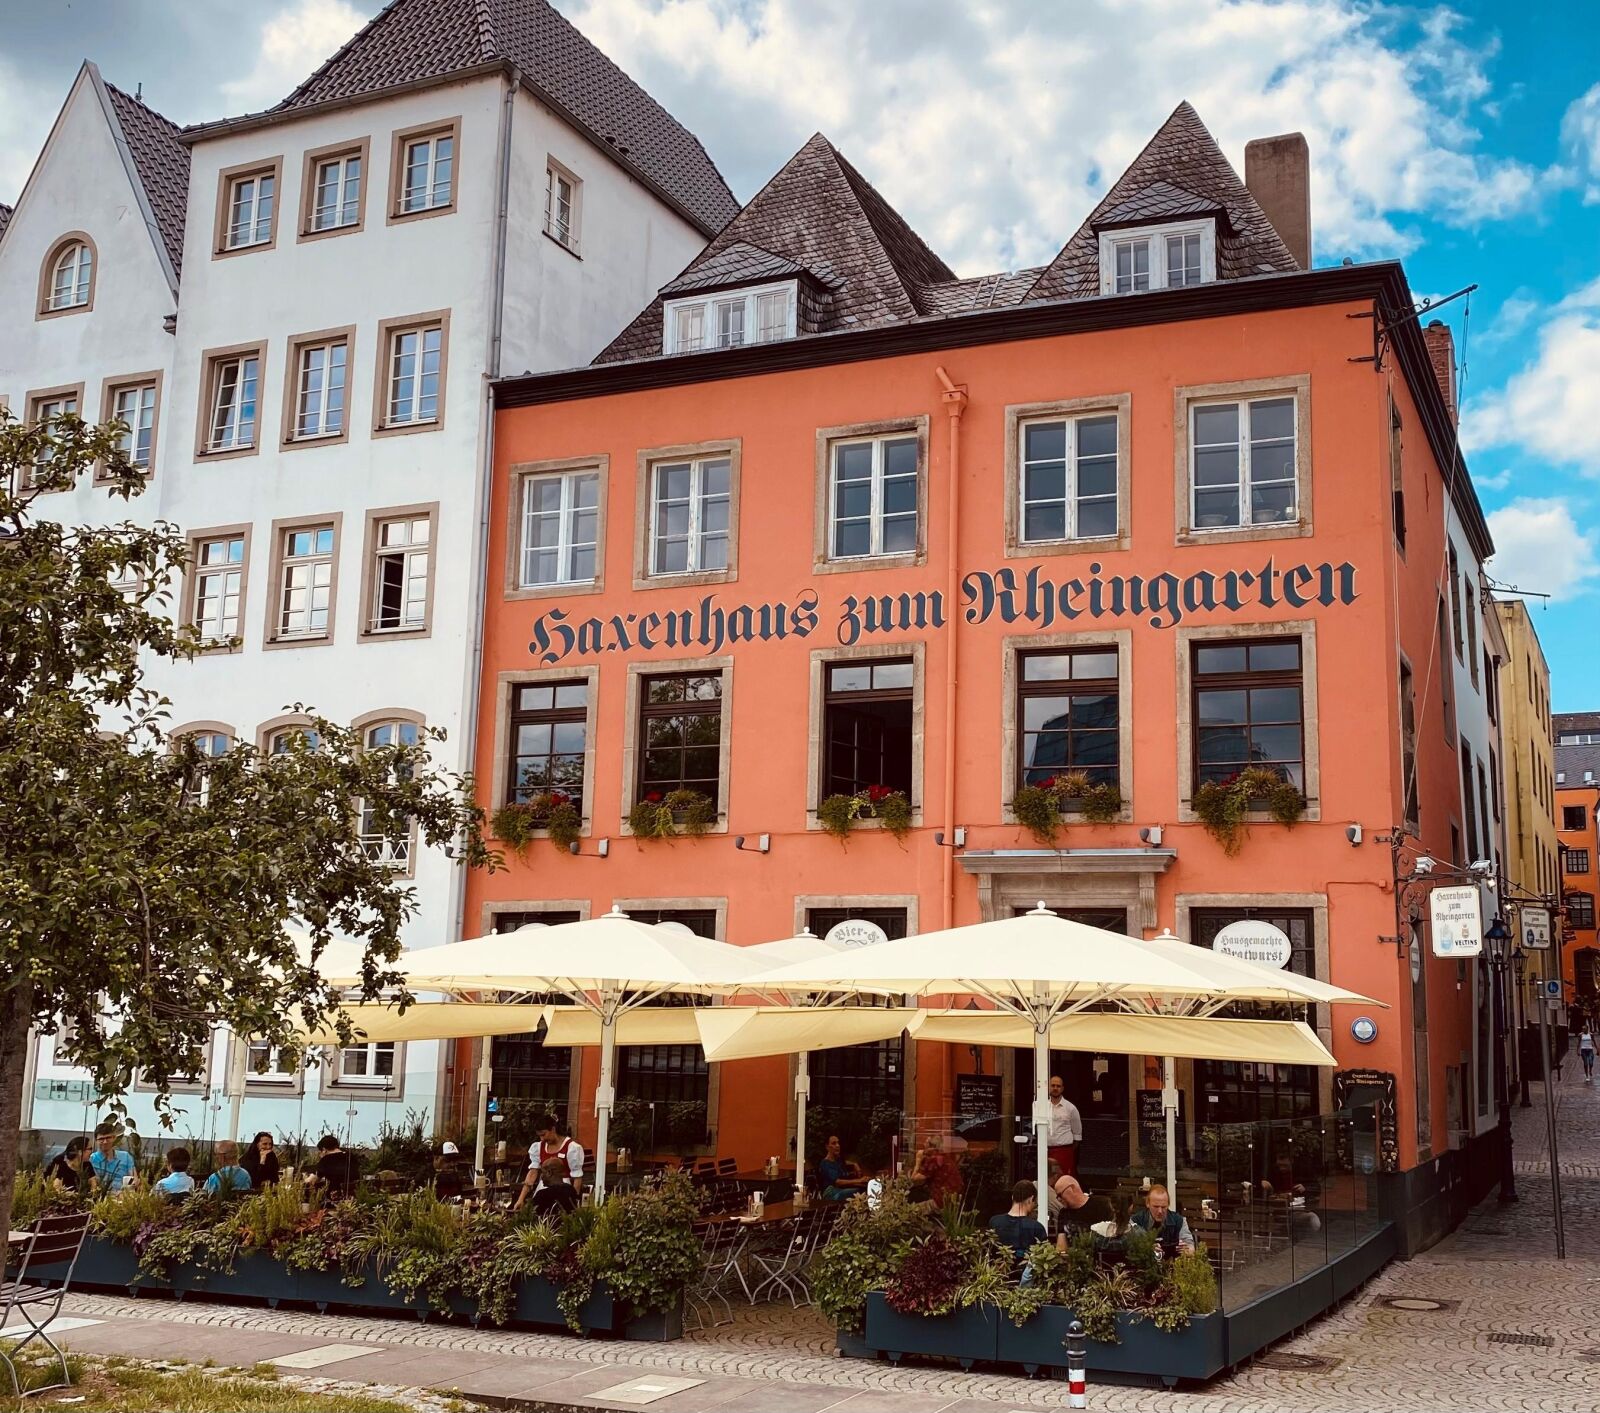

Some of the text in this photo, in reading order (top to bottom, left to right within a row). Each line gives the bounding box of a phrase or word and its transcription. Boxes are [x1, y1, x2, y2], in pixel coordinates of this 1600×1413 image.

[529, 554, 1361, 668] Haxenhaus zum Rheingarten
[1221, 935, 1283, 948] Hausgemachte
